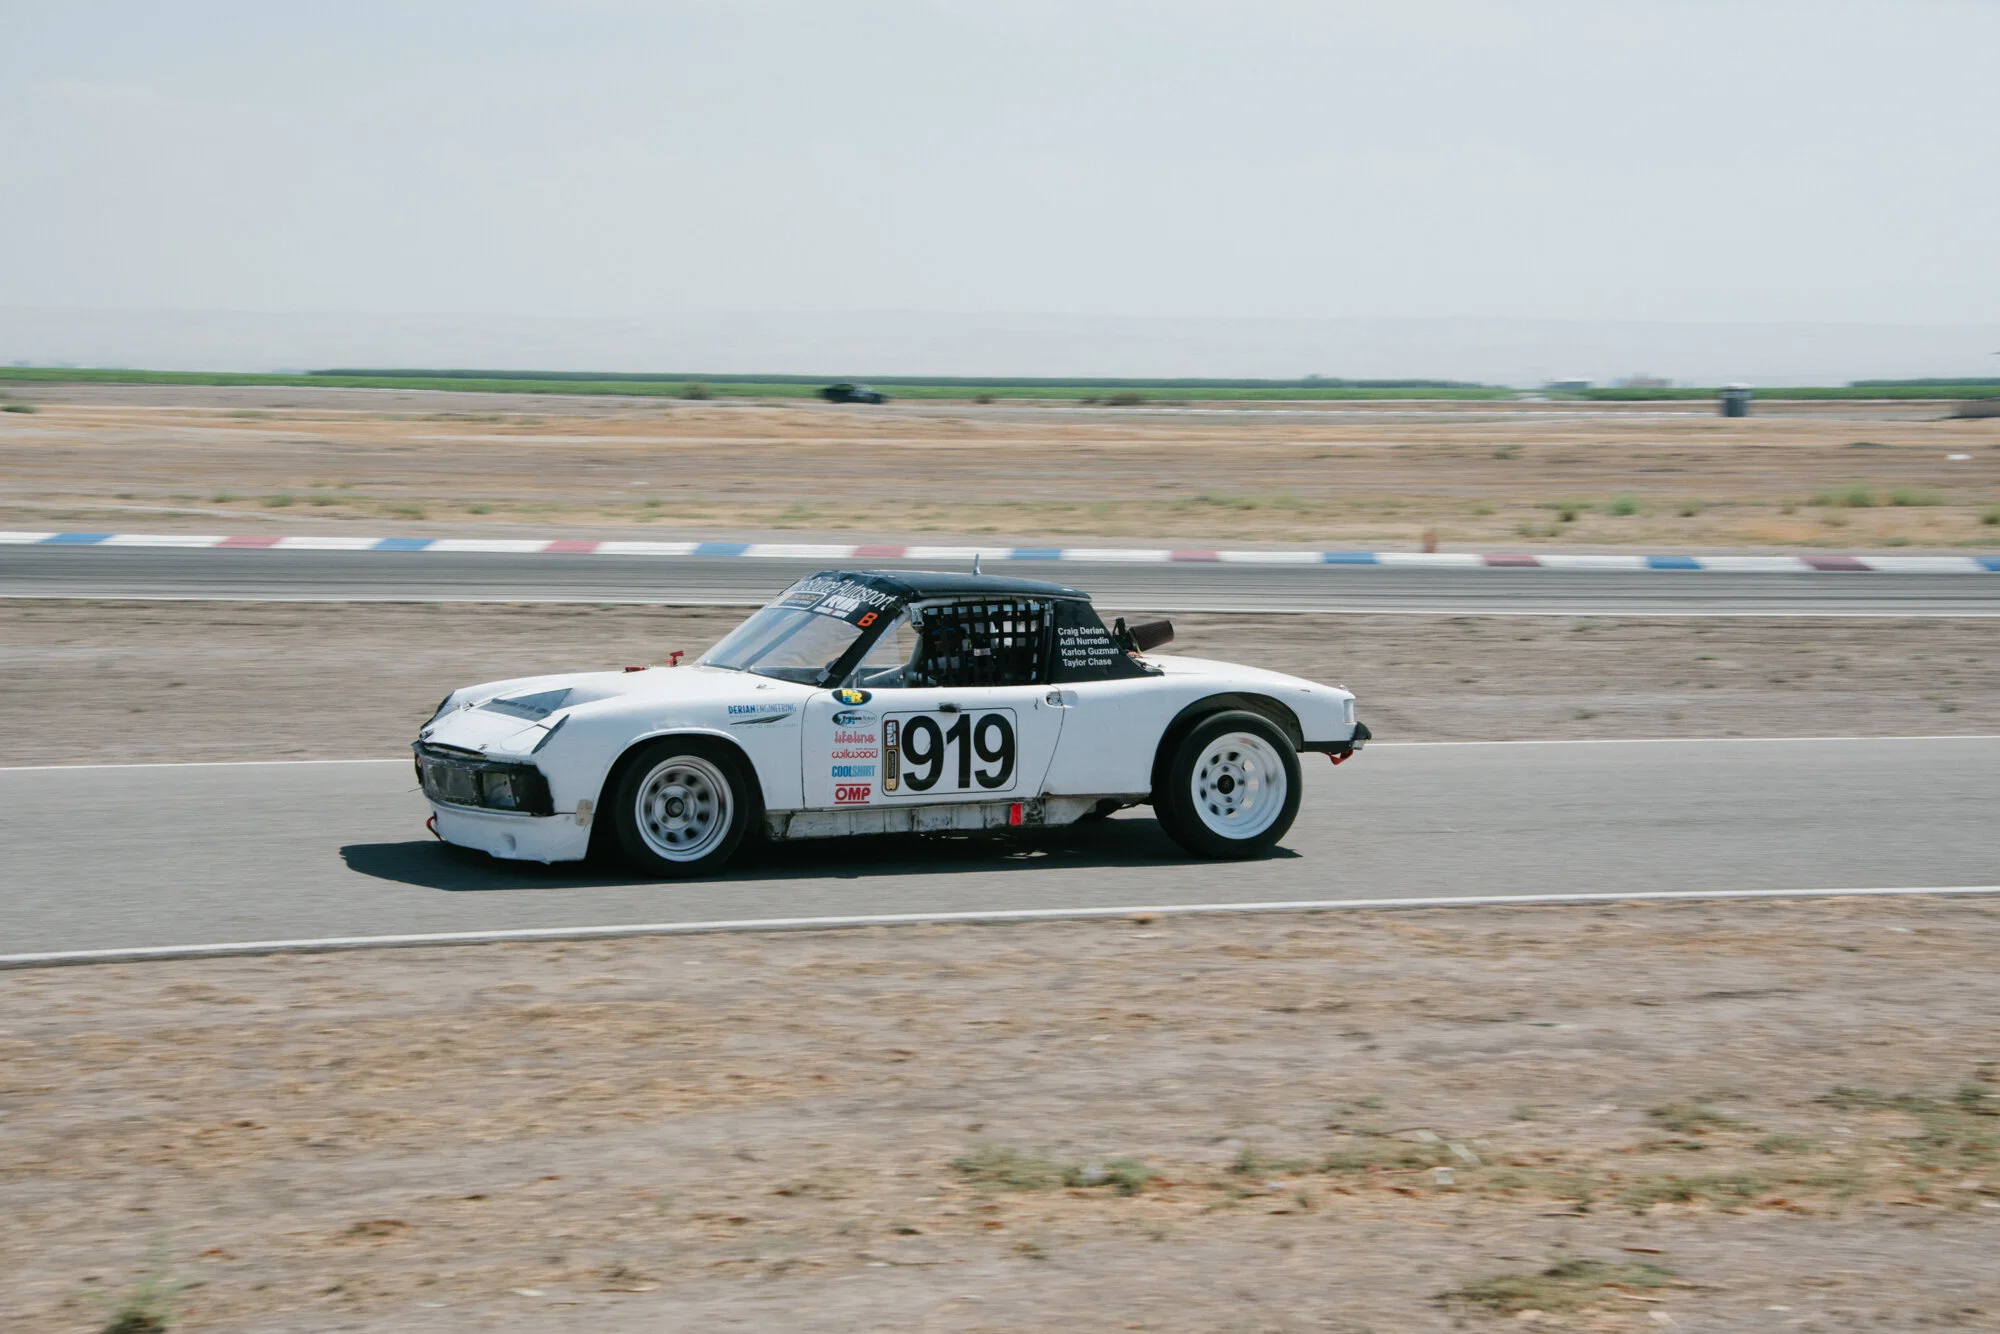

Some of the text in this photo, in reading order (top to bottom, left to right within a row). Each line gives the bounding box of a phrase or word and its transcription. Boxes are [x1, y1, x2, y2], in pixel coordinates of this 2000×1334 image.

[832, 580, 898, 611] Autosport
[857, 611, 878, 627] B
[1057, 626, 1105, 636] Craig Derian
[1076, 636, 1109, 645] Nurredin
[1061, 647, 1119, 656] Karlos Guzman
[1063, 658, 1112, 668] Taylor Chase
[728, 703, 797, 714] DERIAN ENGINEERING
[834, 730, 876, 744] lifeline
[831, 748, 878, 759] wilwood
[901, 713, 1016, 791] 919
[831, 765, 876, 777] COOLSHIRT
[835, 787, 871, 801] OMP
